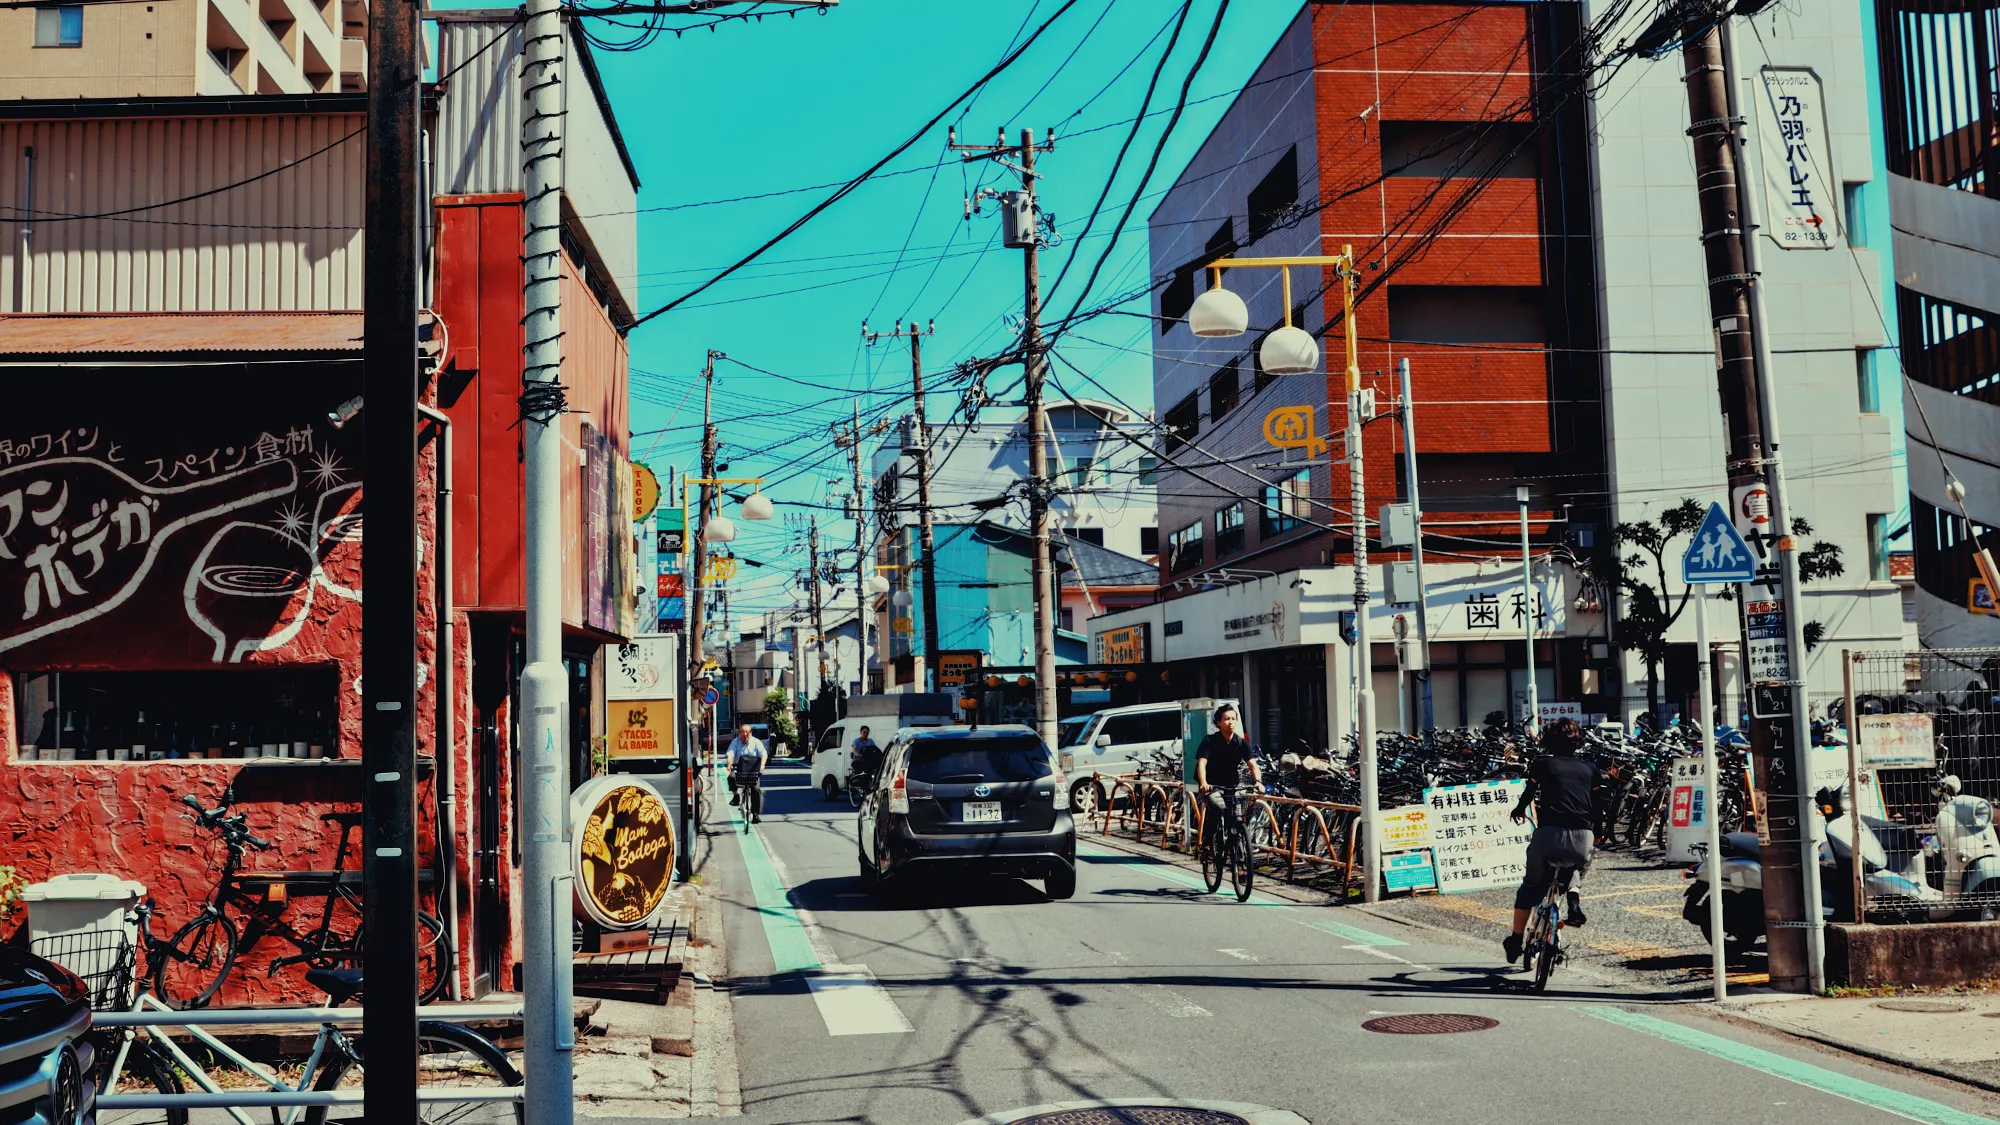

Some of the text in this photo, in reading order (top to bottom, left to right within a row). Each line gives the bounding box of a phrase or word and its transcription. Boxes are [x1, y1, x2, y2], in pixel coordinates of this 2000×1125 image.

[1779, 96, 1814, 206] 乃羽バレエ
[1784, 216, 1804, 226] ここ
[1784, 232, 1828, 242] 82-1339
[144, 423, 314, 484] スペイン食材
[634, 470, 643, 515] TACOS
[21, 496, 161, 621] ボデガ
[1744, 528, 1782, 595] ヤギ
[1463, 591, 1547, 630] 歯科
[1772, 700, 1785, 711] 21
[618, 739, 659, 751] LA BAMBA
[623, 729, 653, 740] TACOS
[973, 808, 1000, 820] 11-32
[1674, 791, 1689, 822] 満車
[1691, 789, 1704, 823] 自転車
[614, 826, 649, 848] Mam
[616, 836, 668, 870] Bodega
